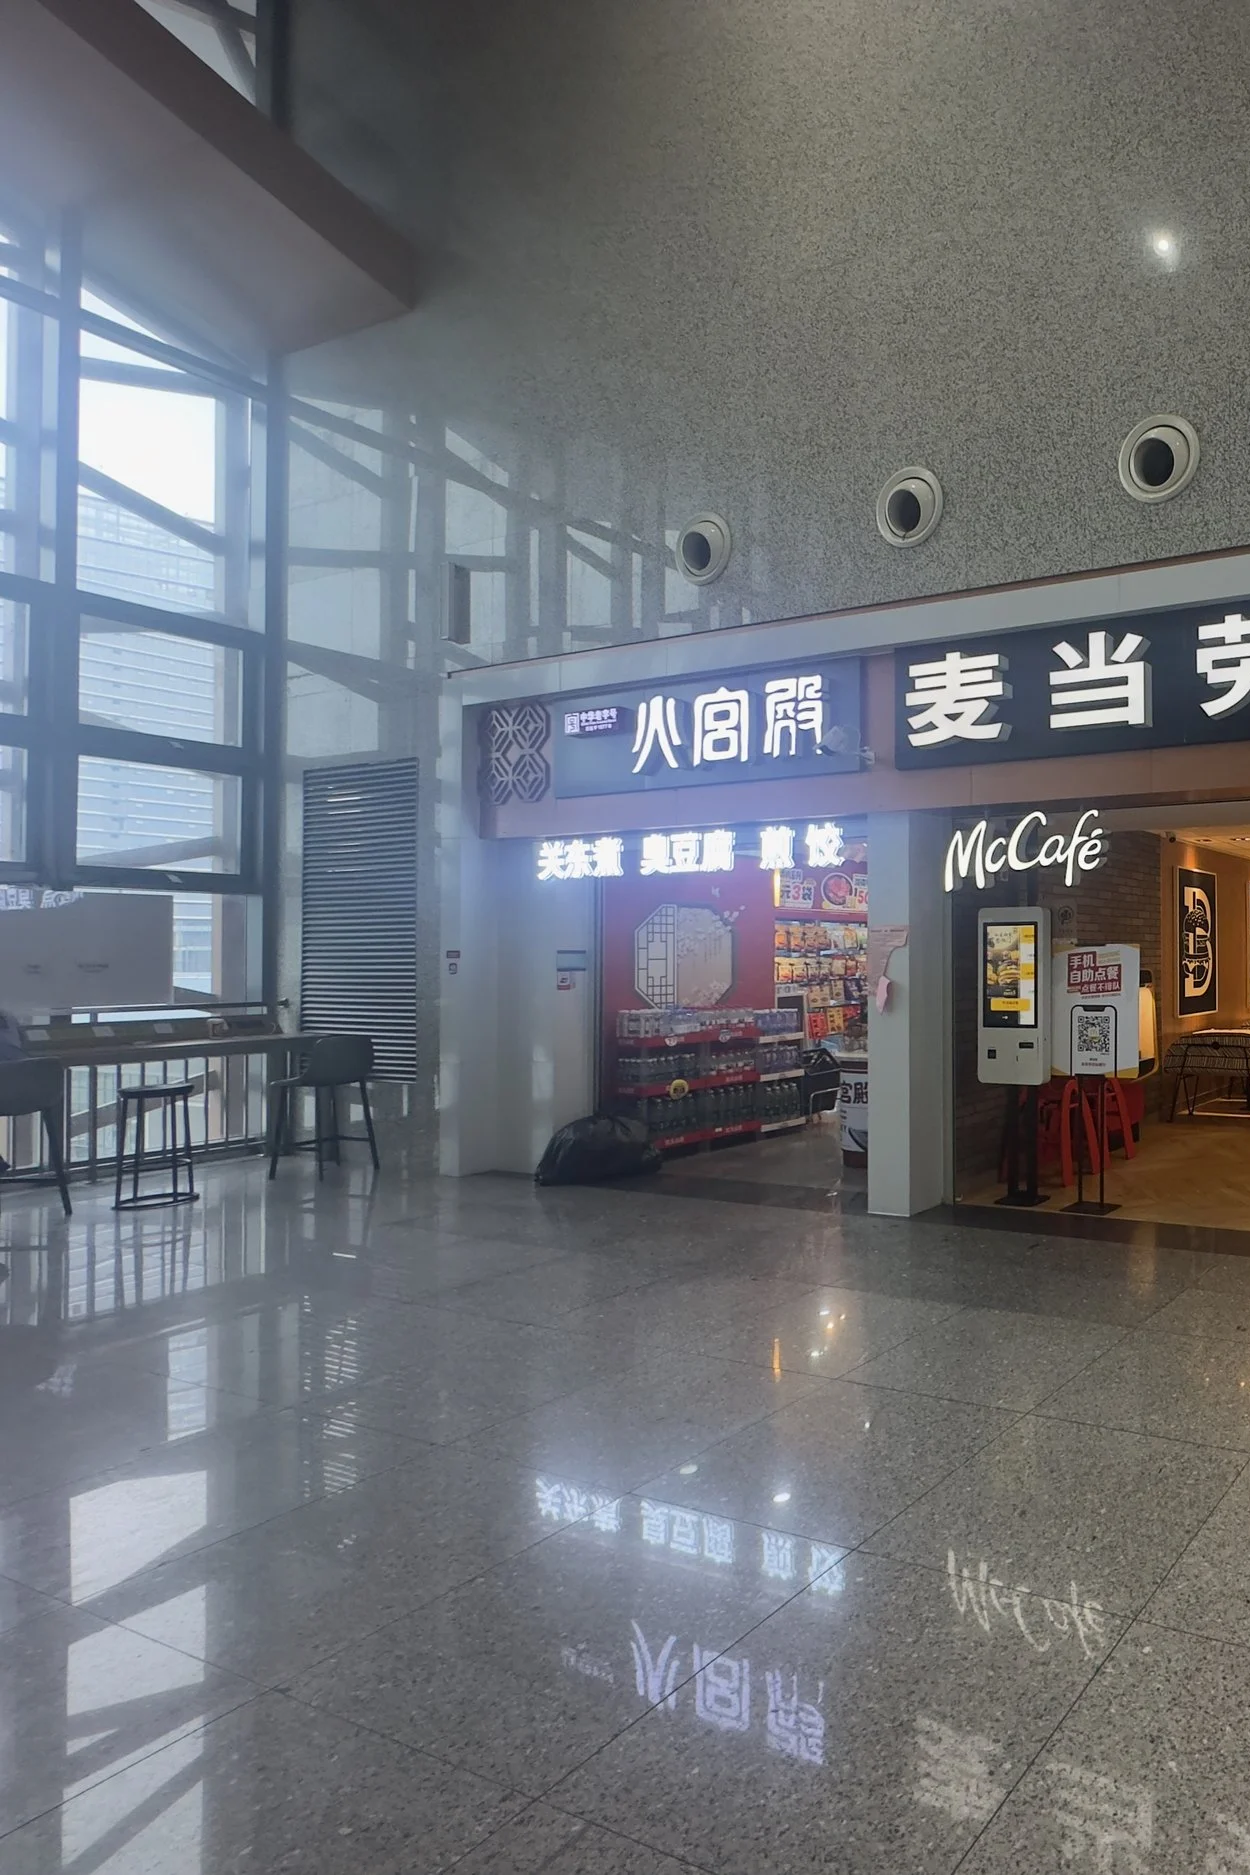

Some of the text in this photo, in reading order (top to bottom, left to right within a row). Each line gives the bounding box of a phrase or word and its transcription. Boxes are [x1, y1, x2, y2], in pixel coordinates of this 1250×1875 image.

[632, 674, 823, 774] 火宫殿
[537, 836, 624, 881] 关东煮
[640, 829, 735, 876] 臭豆腐
[944, 808, 1104, 893] McCafé
[1070, 954, 1095, 969] 手机
[1070, 966, 1119, 984] 自助点餐
[1081, 981, 1120, 993] 点餐不排队
